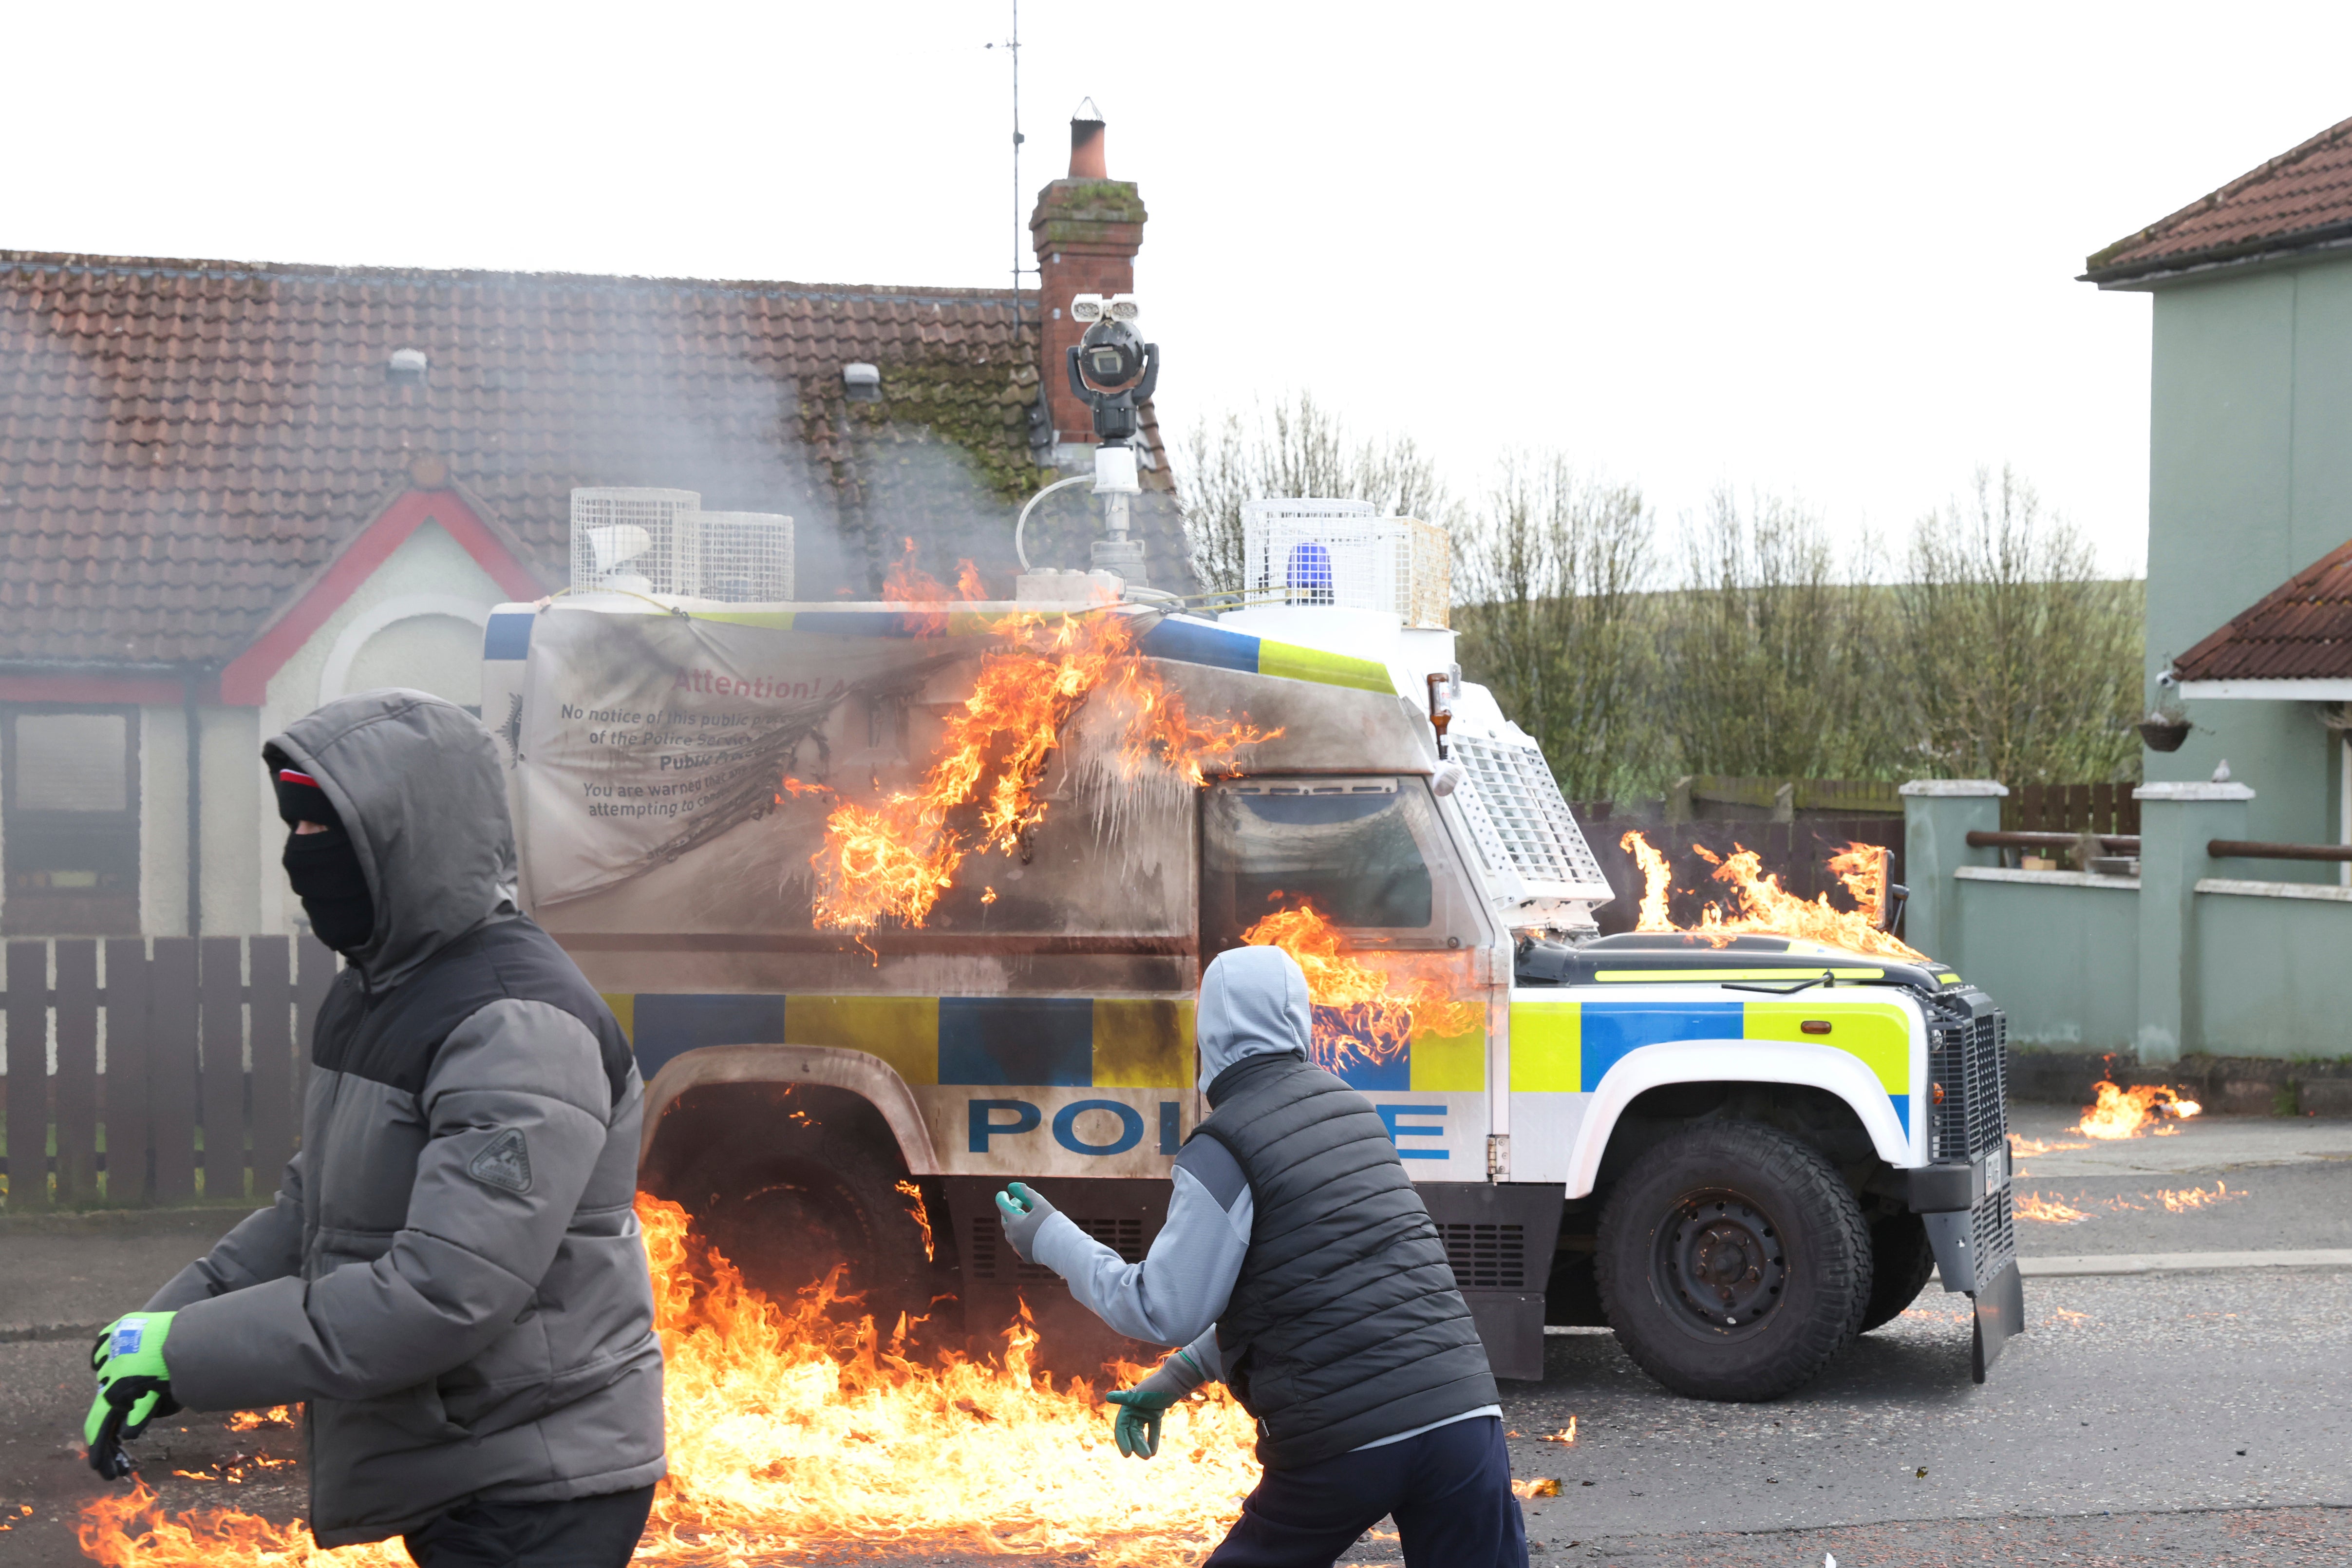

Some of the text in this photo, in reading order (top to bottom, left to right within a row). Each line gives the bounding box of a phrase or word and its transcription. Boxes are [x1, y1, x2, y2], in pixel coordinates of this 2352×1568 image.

[671, 667, 821, 699] Attention!
[561, 704, 583, 719] No
[588, 708, 641, 723] notice
[646, 710, 663, 724] of
[667, 710, 696, 725] this
[700, 713, 749, 728] public
[589, 730, 606, 744] of
[611, 731, 638, 745] the
[643, 731, 693, 746] Police
[583, 782, 612, 797] You
[618, 786, 643, 797] are
[648, 777, 701, 796] warned
[589, 800, 694, 819] attempting to
[968, 1099, 1449, 1160] POLE
